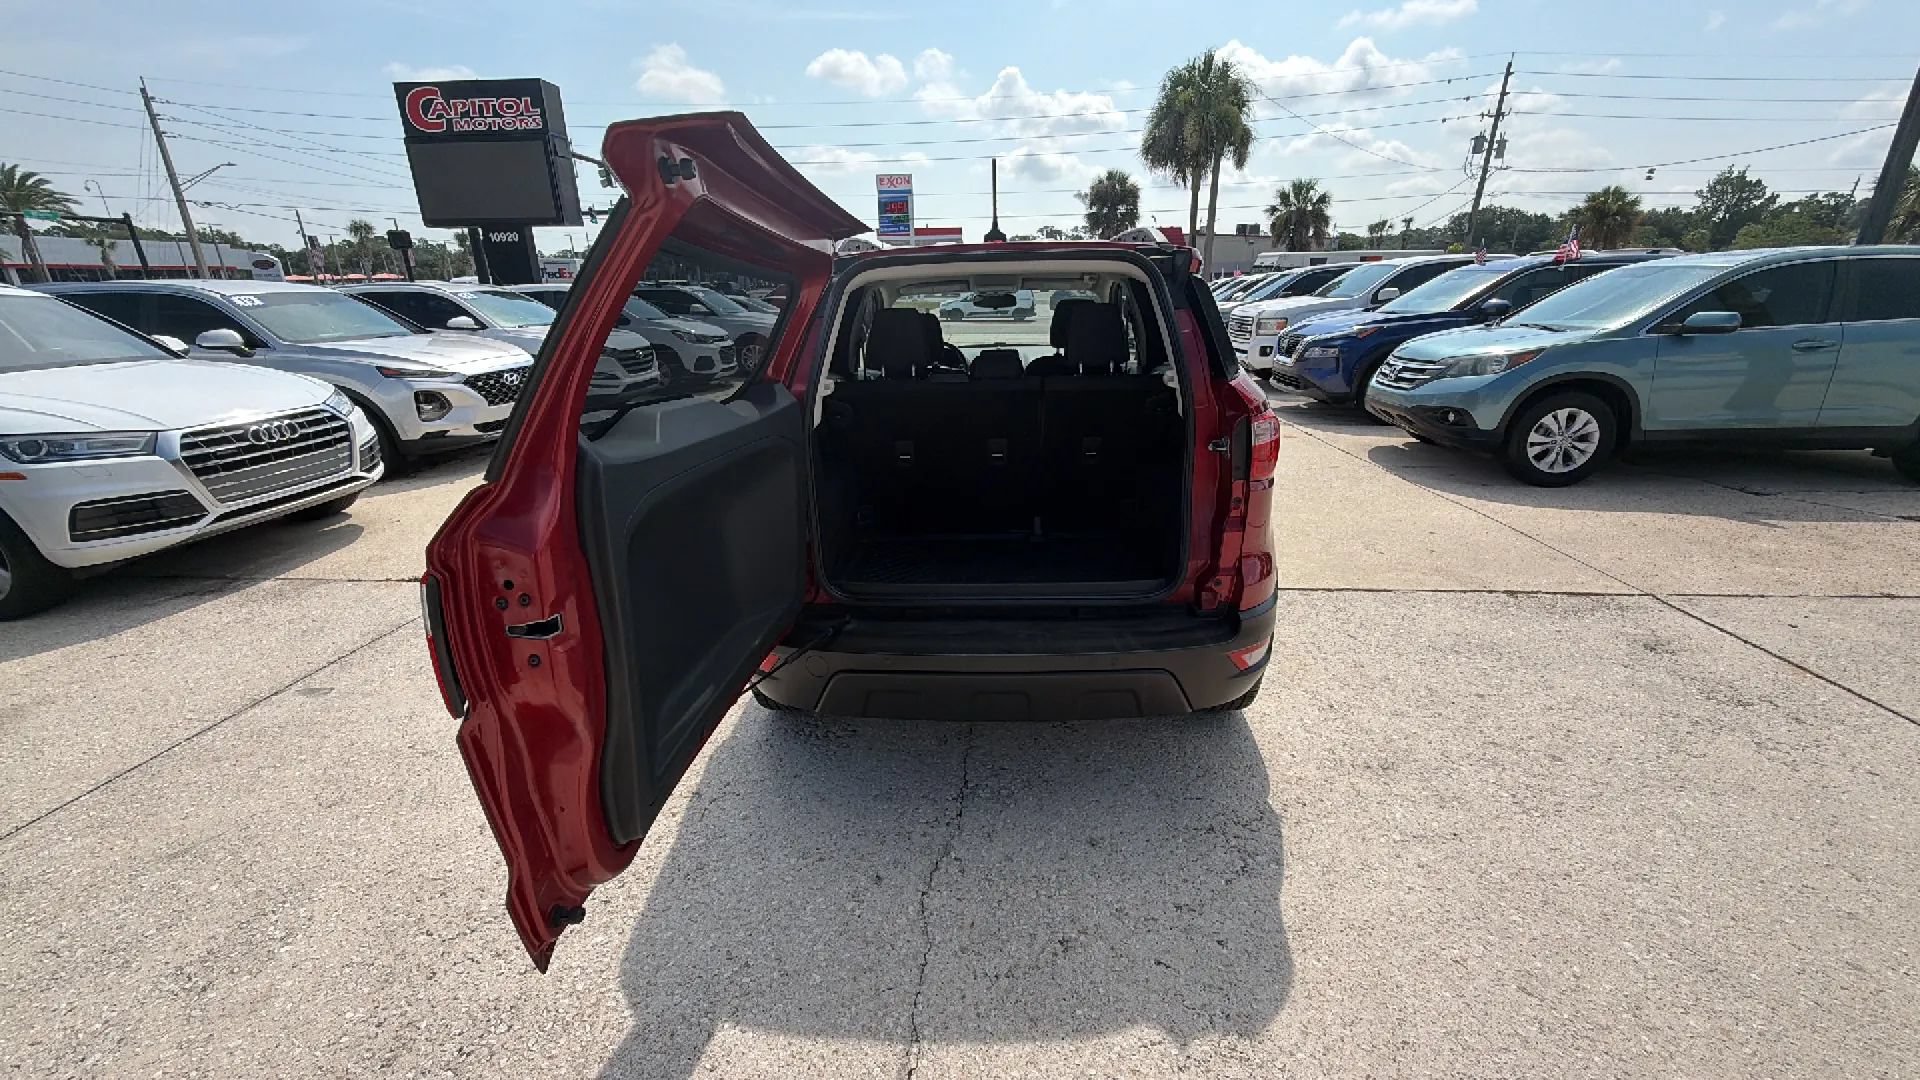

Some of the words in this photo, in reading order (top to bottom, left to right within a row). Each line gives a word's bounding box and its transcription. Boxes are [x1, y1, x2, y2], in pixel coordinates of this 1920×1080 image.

[405, 86, 541, 133] CAPITOL
[453, 116, 543, 132] MOTORS
[879, 176, 911, 189] EXXON
[489, 231, 519, 243] 10920
[540, 267, 575, 279] FedEx
